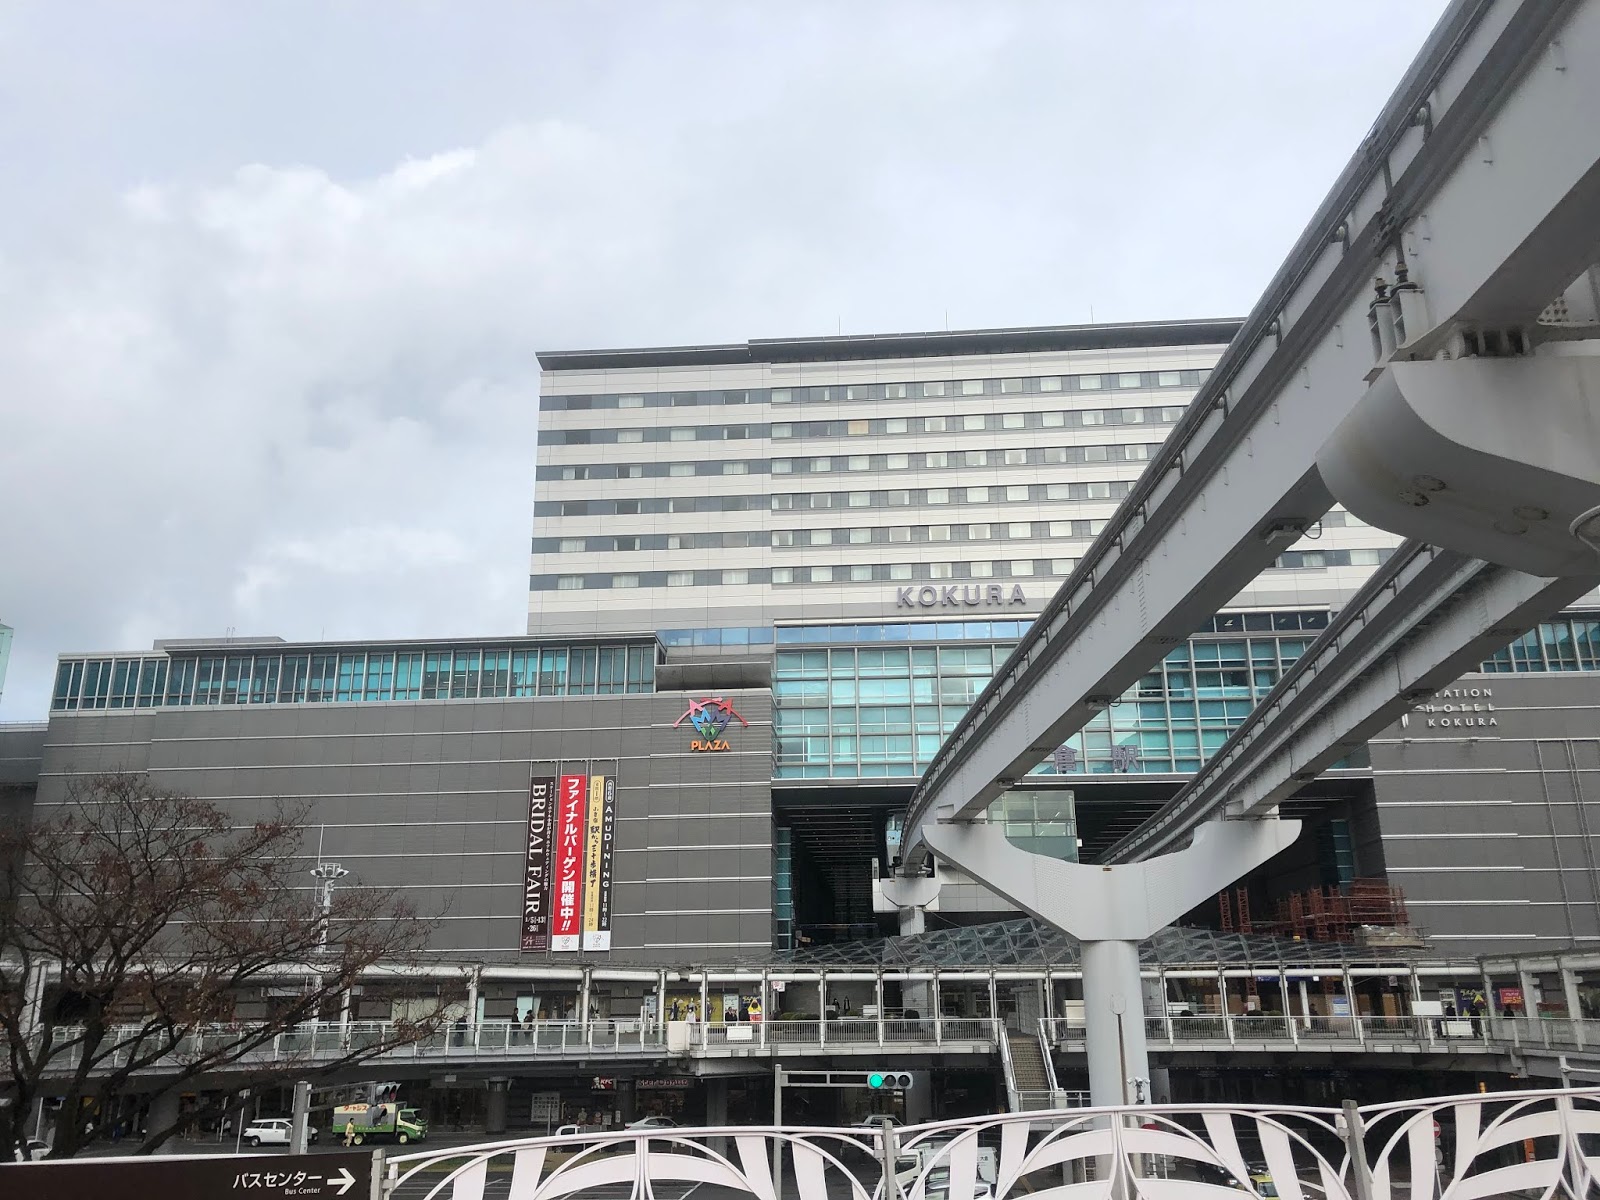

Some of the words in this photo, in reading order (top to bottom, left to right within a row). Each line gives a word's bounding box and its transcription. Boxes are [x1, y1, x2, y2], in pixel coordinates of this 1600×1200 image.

[897, 583, 1027, 608] KOKURA
[1435, 689, 1492, 698] ATION
[1426, 703, 1495, 713] HOTEL
[1428, 718, 1498, 727] KOKURA
[690, 740, 731, 751] PLAZA
[1052, 744, 1141, 772] 倉駅
[528, 783, 547, 860] BRIDAL
[560, 778, 580, 932] ファイナルバーゲン開催中!!
[525, 865, 542, 915] FAIR
[232, 1170, 323, 1189] バスセンター
[298, 1187, 321, 1195] Center
